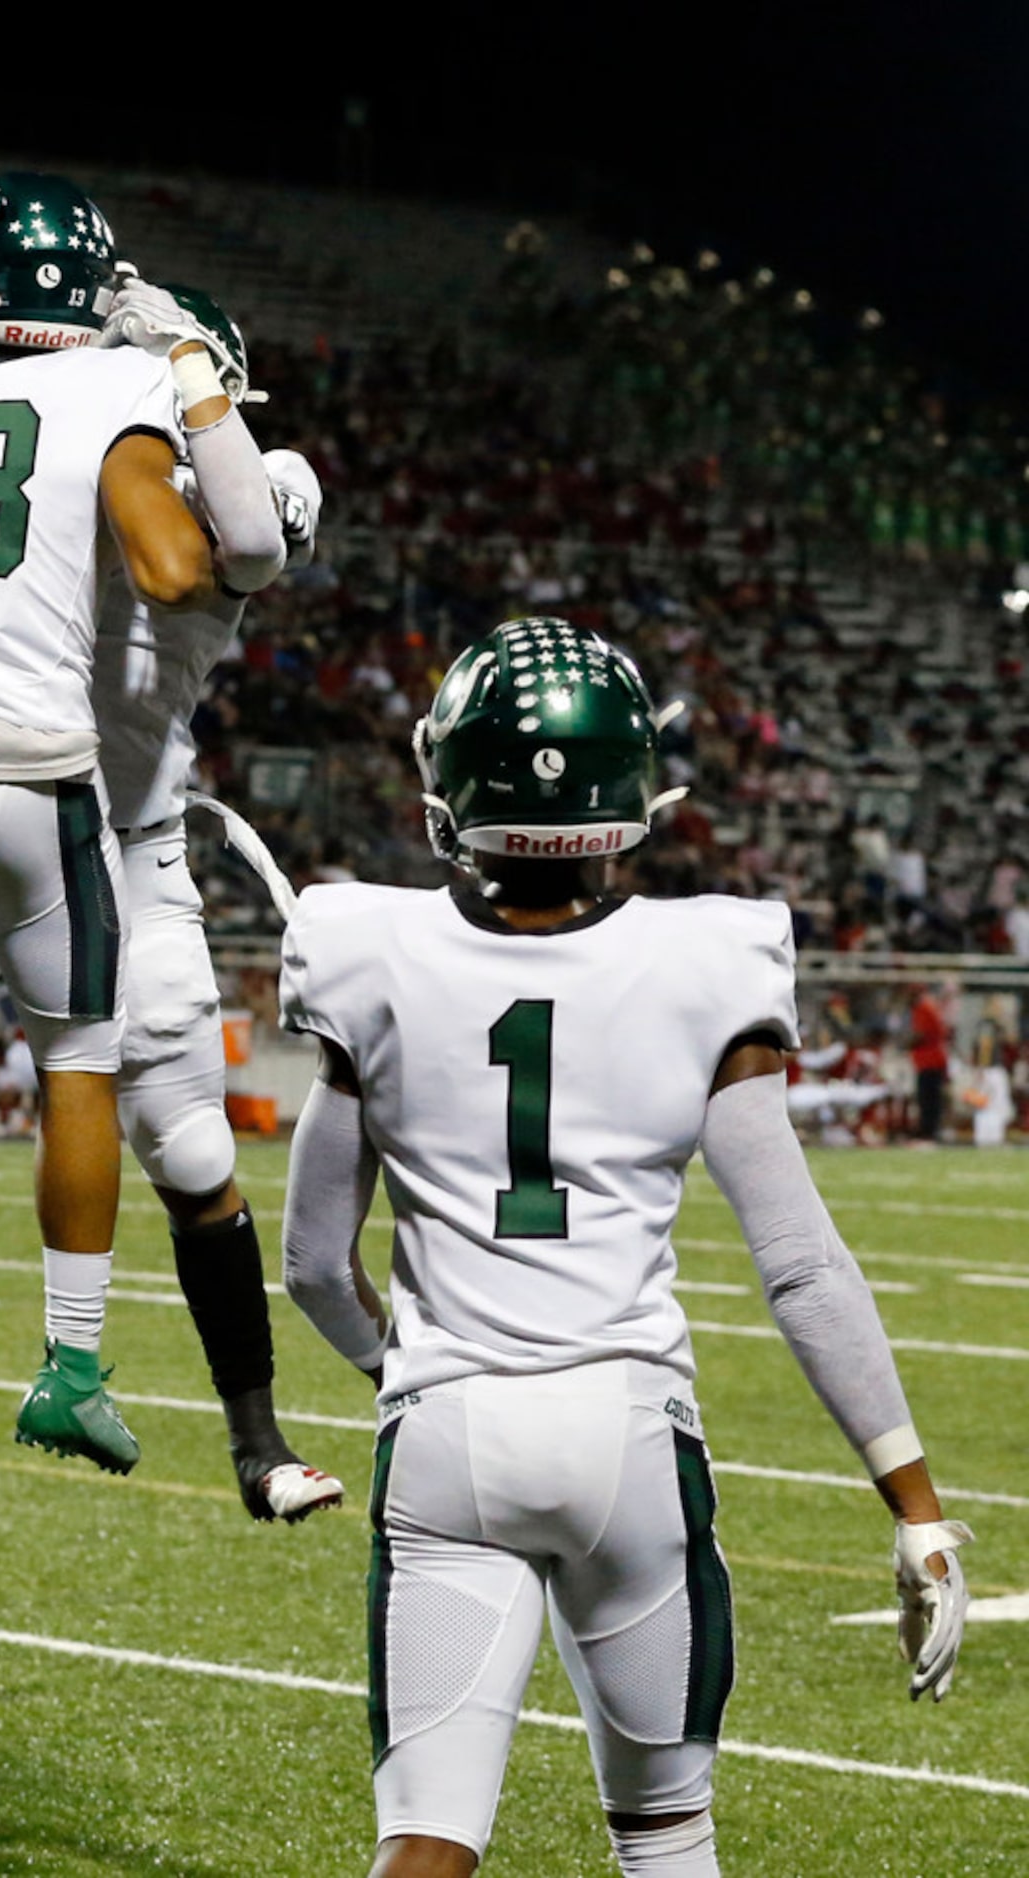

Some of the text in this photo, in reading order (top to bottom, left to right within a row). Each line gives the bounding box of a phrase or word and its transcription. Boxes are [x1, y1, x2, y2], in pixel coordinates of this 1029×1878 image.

[68, 287, 86, 307] 13
[4, 324, 91, 347] Riddell
[588, 784, 600, 808] 1
[504, 829, 623, 856] Riddell
[487, 998, 569, 1240] 1
